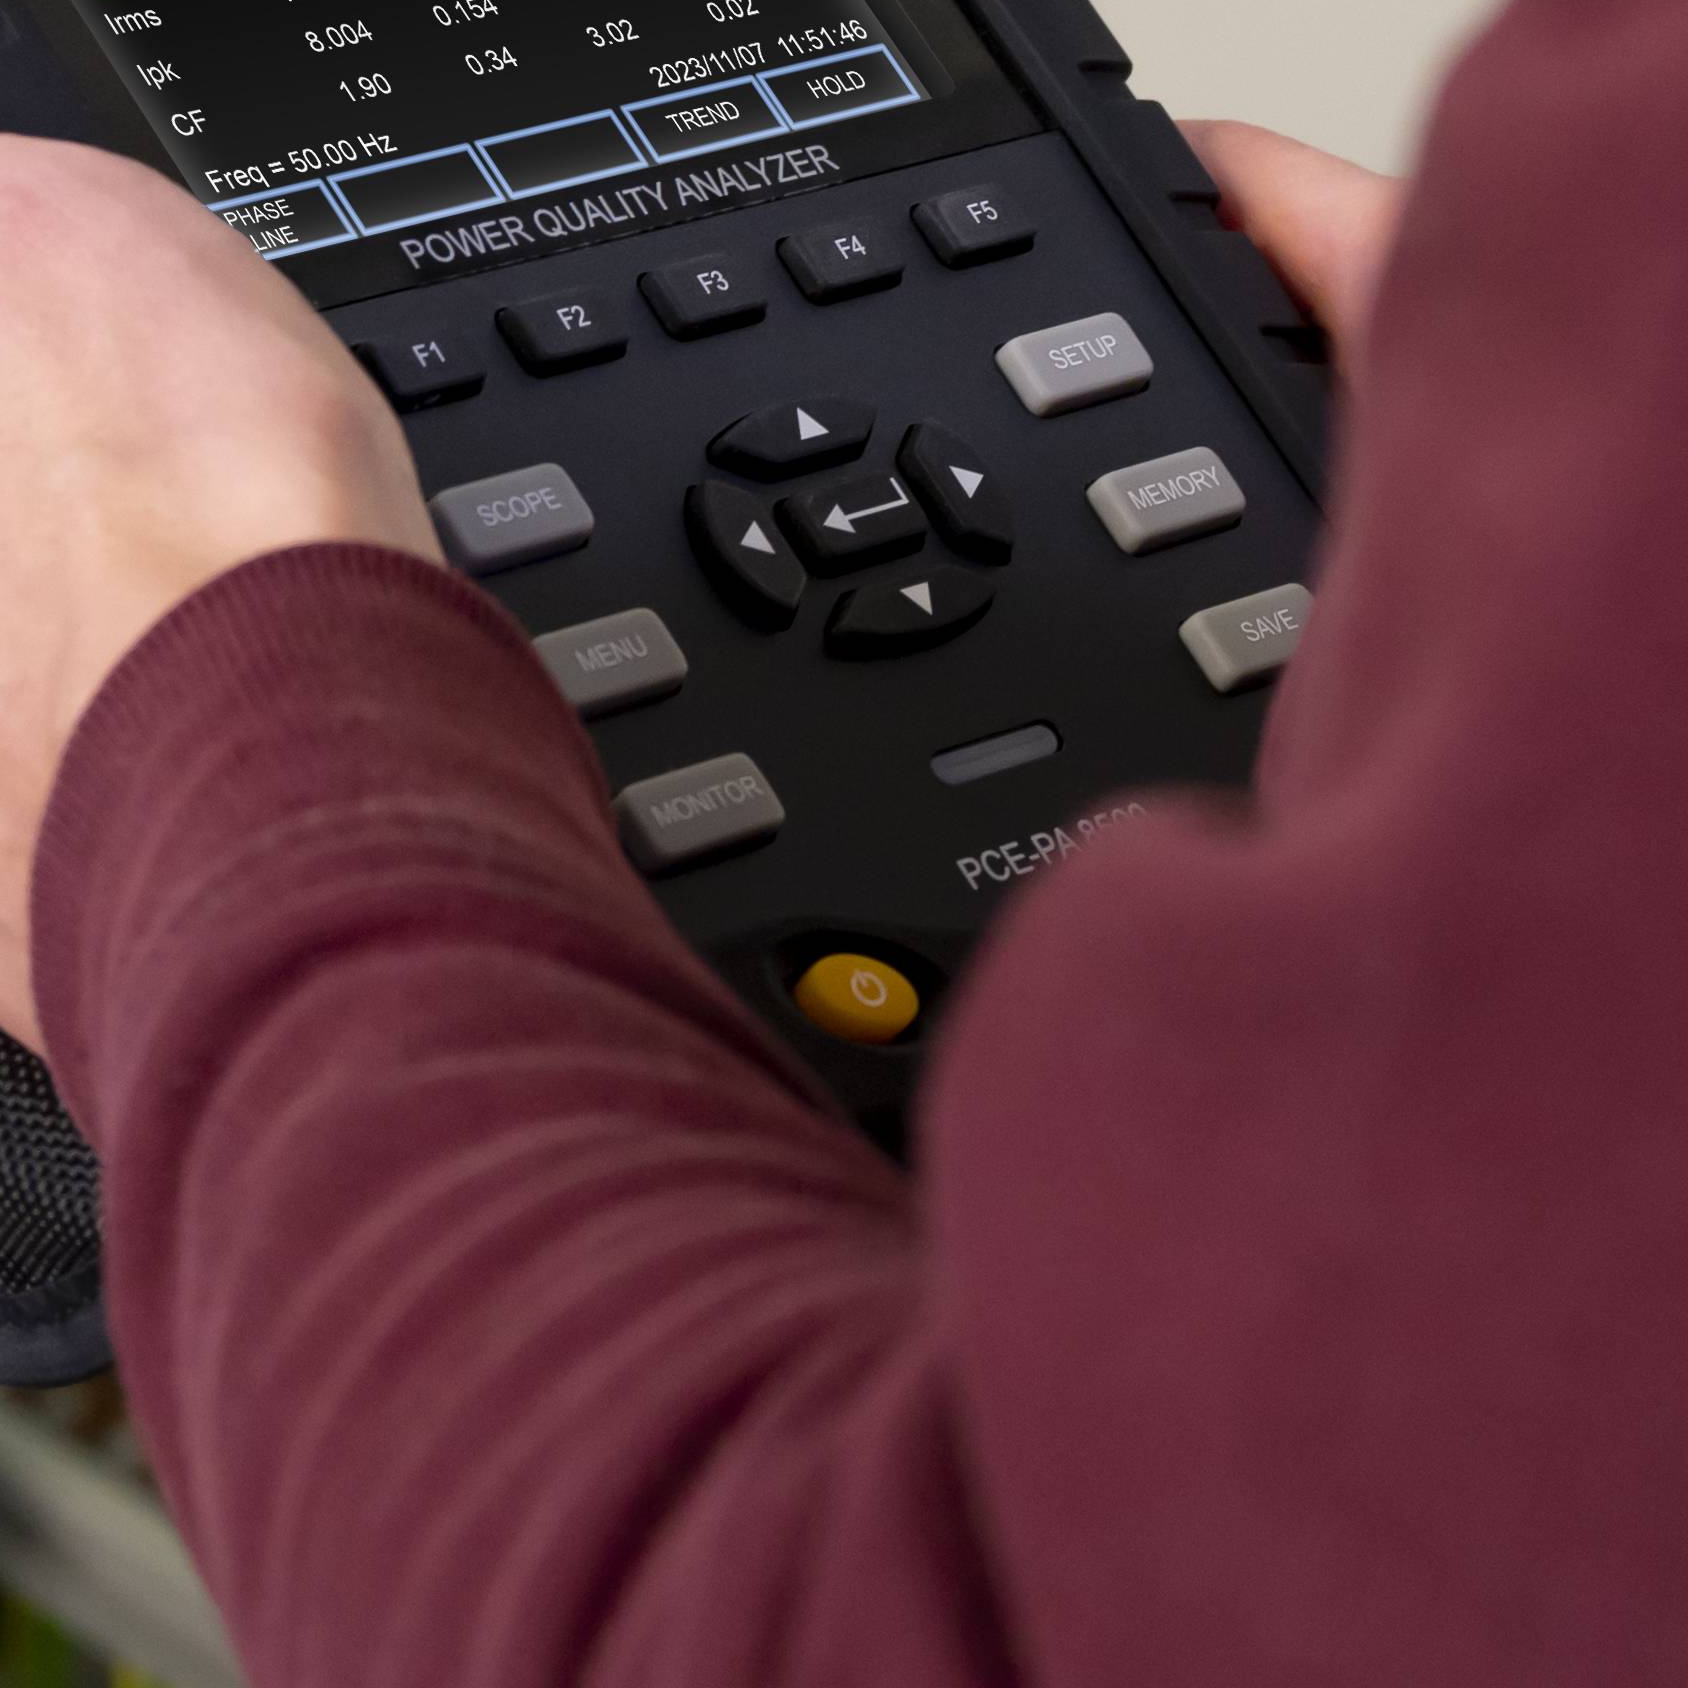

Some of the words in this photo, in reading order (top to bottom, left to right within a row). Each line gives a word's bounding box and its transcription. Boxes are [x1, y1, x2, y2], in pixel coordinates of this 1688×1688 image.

[104, 9, 162, 35] Irms
[136, 60, 181, 91] Ipk
[304, 20, 373, 52] 8.004
[649, 42, 766, 88] 2023/11/07
[777, 19, 868, 57] 11:51:46
[171, 109, 206, 136] CF
[339, 73, 392, 102] 1.90
[465, 46, 518, 76] 0.34
[585, 19, 640, 47] 3.02
[806, 70, 866, 99] HOLD
[665, 101, 740, 133] TREND
[205, 166, 270, 193] Freq
[287, 139, 358, 173] 50.00
[357, 133, 398, 158] Hz
[223, 199, 295, 228] PHASE
[399, 215, 535, 270] POWER
[533, 181, 670, 238] QUALITY
[674, 144, 840, 207] ANALYZER
[966, 200, 998, 224] F5
[249, 226, 299, 252] LINE
[834, 235, 866, 260] F4
[697, 270, 729, 295] F3
[556, 305, 592, 331] F2
[412, 341, 446, 367] F1
[1048, 334, 1117, 370] SETUP
[1127, 466, 1221, 510] MEMORY
[476, 487, 562, 527] SCOPE
[1240, 608, 1299, 642] SAVE
[575, 634, 649, 672] MENU
[650, 775, 764, 826] MONITOR
[956, 826, 1084, 891] PCE-PA
